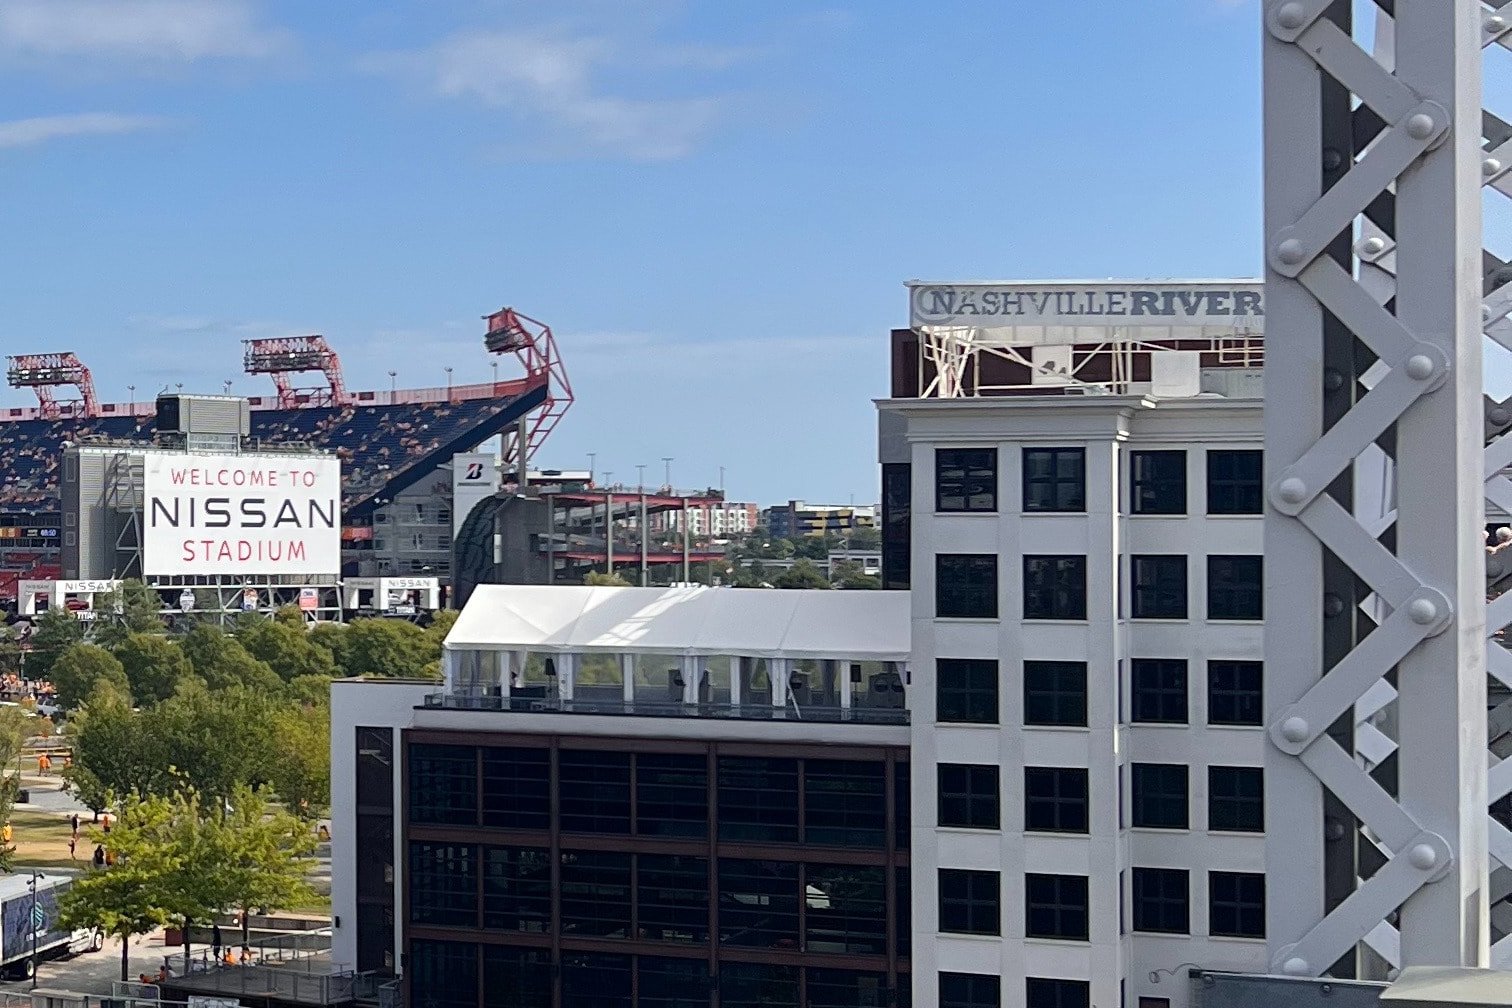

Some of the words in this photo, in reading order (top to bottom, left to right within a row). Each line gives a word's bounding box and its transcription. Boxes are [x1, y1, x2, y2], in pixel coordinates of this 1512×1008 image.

[170, 468, 278, 487] WELCOME
[290, 471, 316, 488] TO
[151, 496, 335, 528] NISSAN
[182, 539, 306, 562] STADIUM
